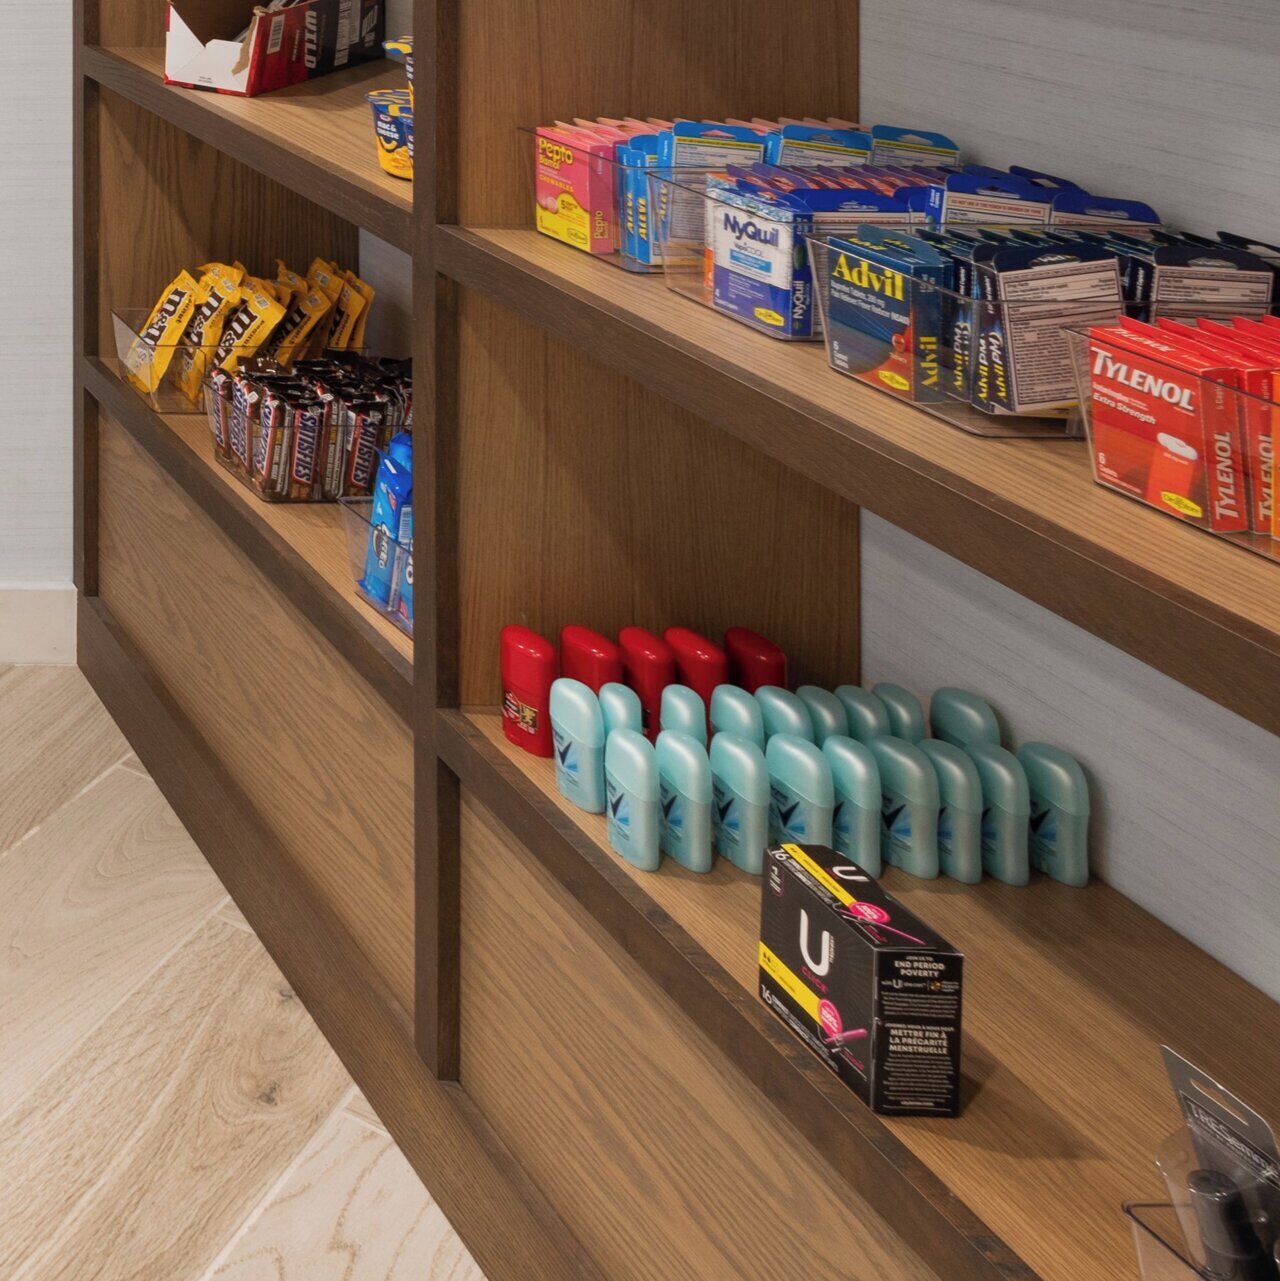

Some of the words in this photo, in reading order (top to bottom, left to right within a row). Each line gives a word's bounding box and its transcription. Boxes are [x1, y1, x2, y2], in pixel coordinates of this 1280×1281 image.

[304, 10, 317, 69] WILD
[539, 137, 574, 165] Pepto
[593, 210, 604, 239] Pepto
[723, 212, 779, 248] NyQuil
[832, 252, 905, 302] Advil
[793, 280, 805, 320] NyQuil
[919, 336, 939, 390] Advil
[1091, 346, 1195, 411] TYLENOL
[293, 412, 318, 484] SATISFIES
[1214, 431, 1239, 520] TYLENOL
[771, 847, 790, 863] 16
[799, 907, 831, 977] U
[894, 960, 912, 968] END
[913, 962, 946, 971] PERIOD
[900, 968, 940, 978] POVERTY
[760, 984, 773, 1005] 16
[889, 1036, 901, 1044] LA
[889, 1044, 948, 1054] MENSTRUELLE
[890, 1028, 924, 1038] METTRE
[925, 1030, 940, 1038] FIN
